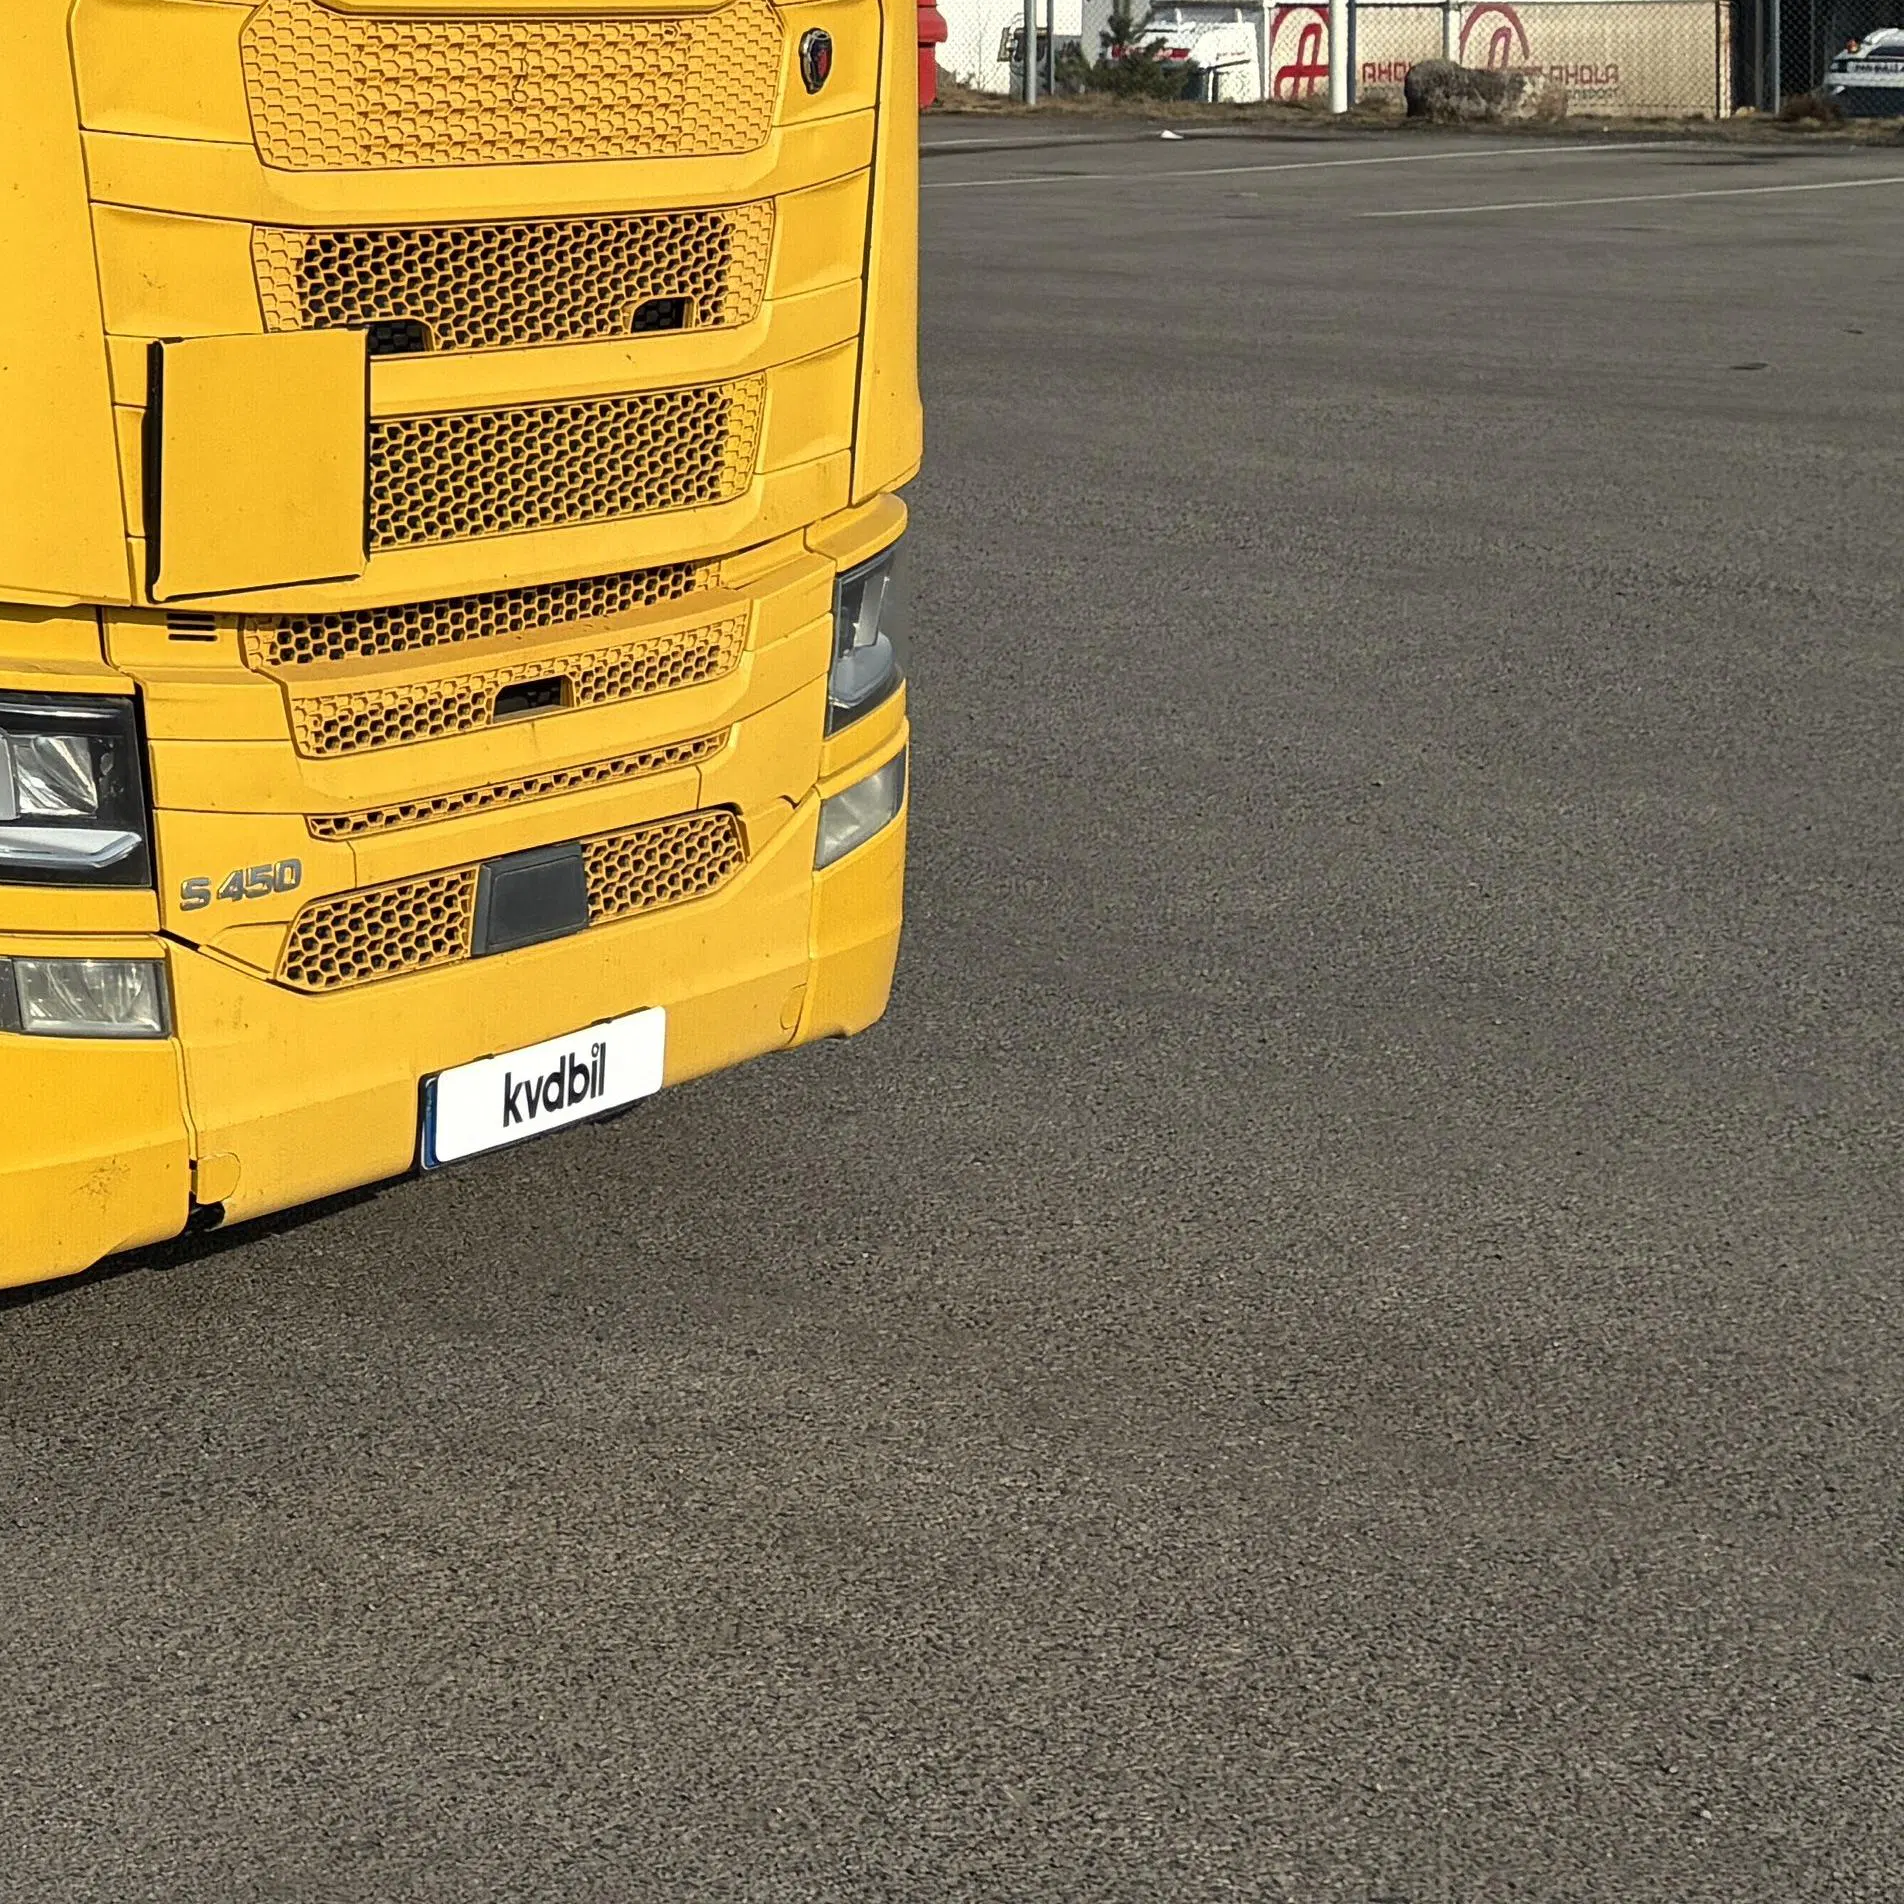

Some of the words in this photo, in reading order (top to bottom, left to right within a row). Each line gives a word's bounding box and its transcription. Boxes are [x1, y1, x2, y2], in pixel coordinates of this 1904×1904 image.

[1362, 61, 1415, 84] AHO
[1550, 53, 1620, 85] AHOLA
[179, 876, 212, 912] S
[215, 857, 302, 903] 450
[502, 1041, 607, 1128] kvdbil
